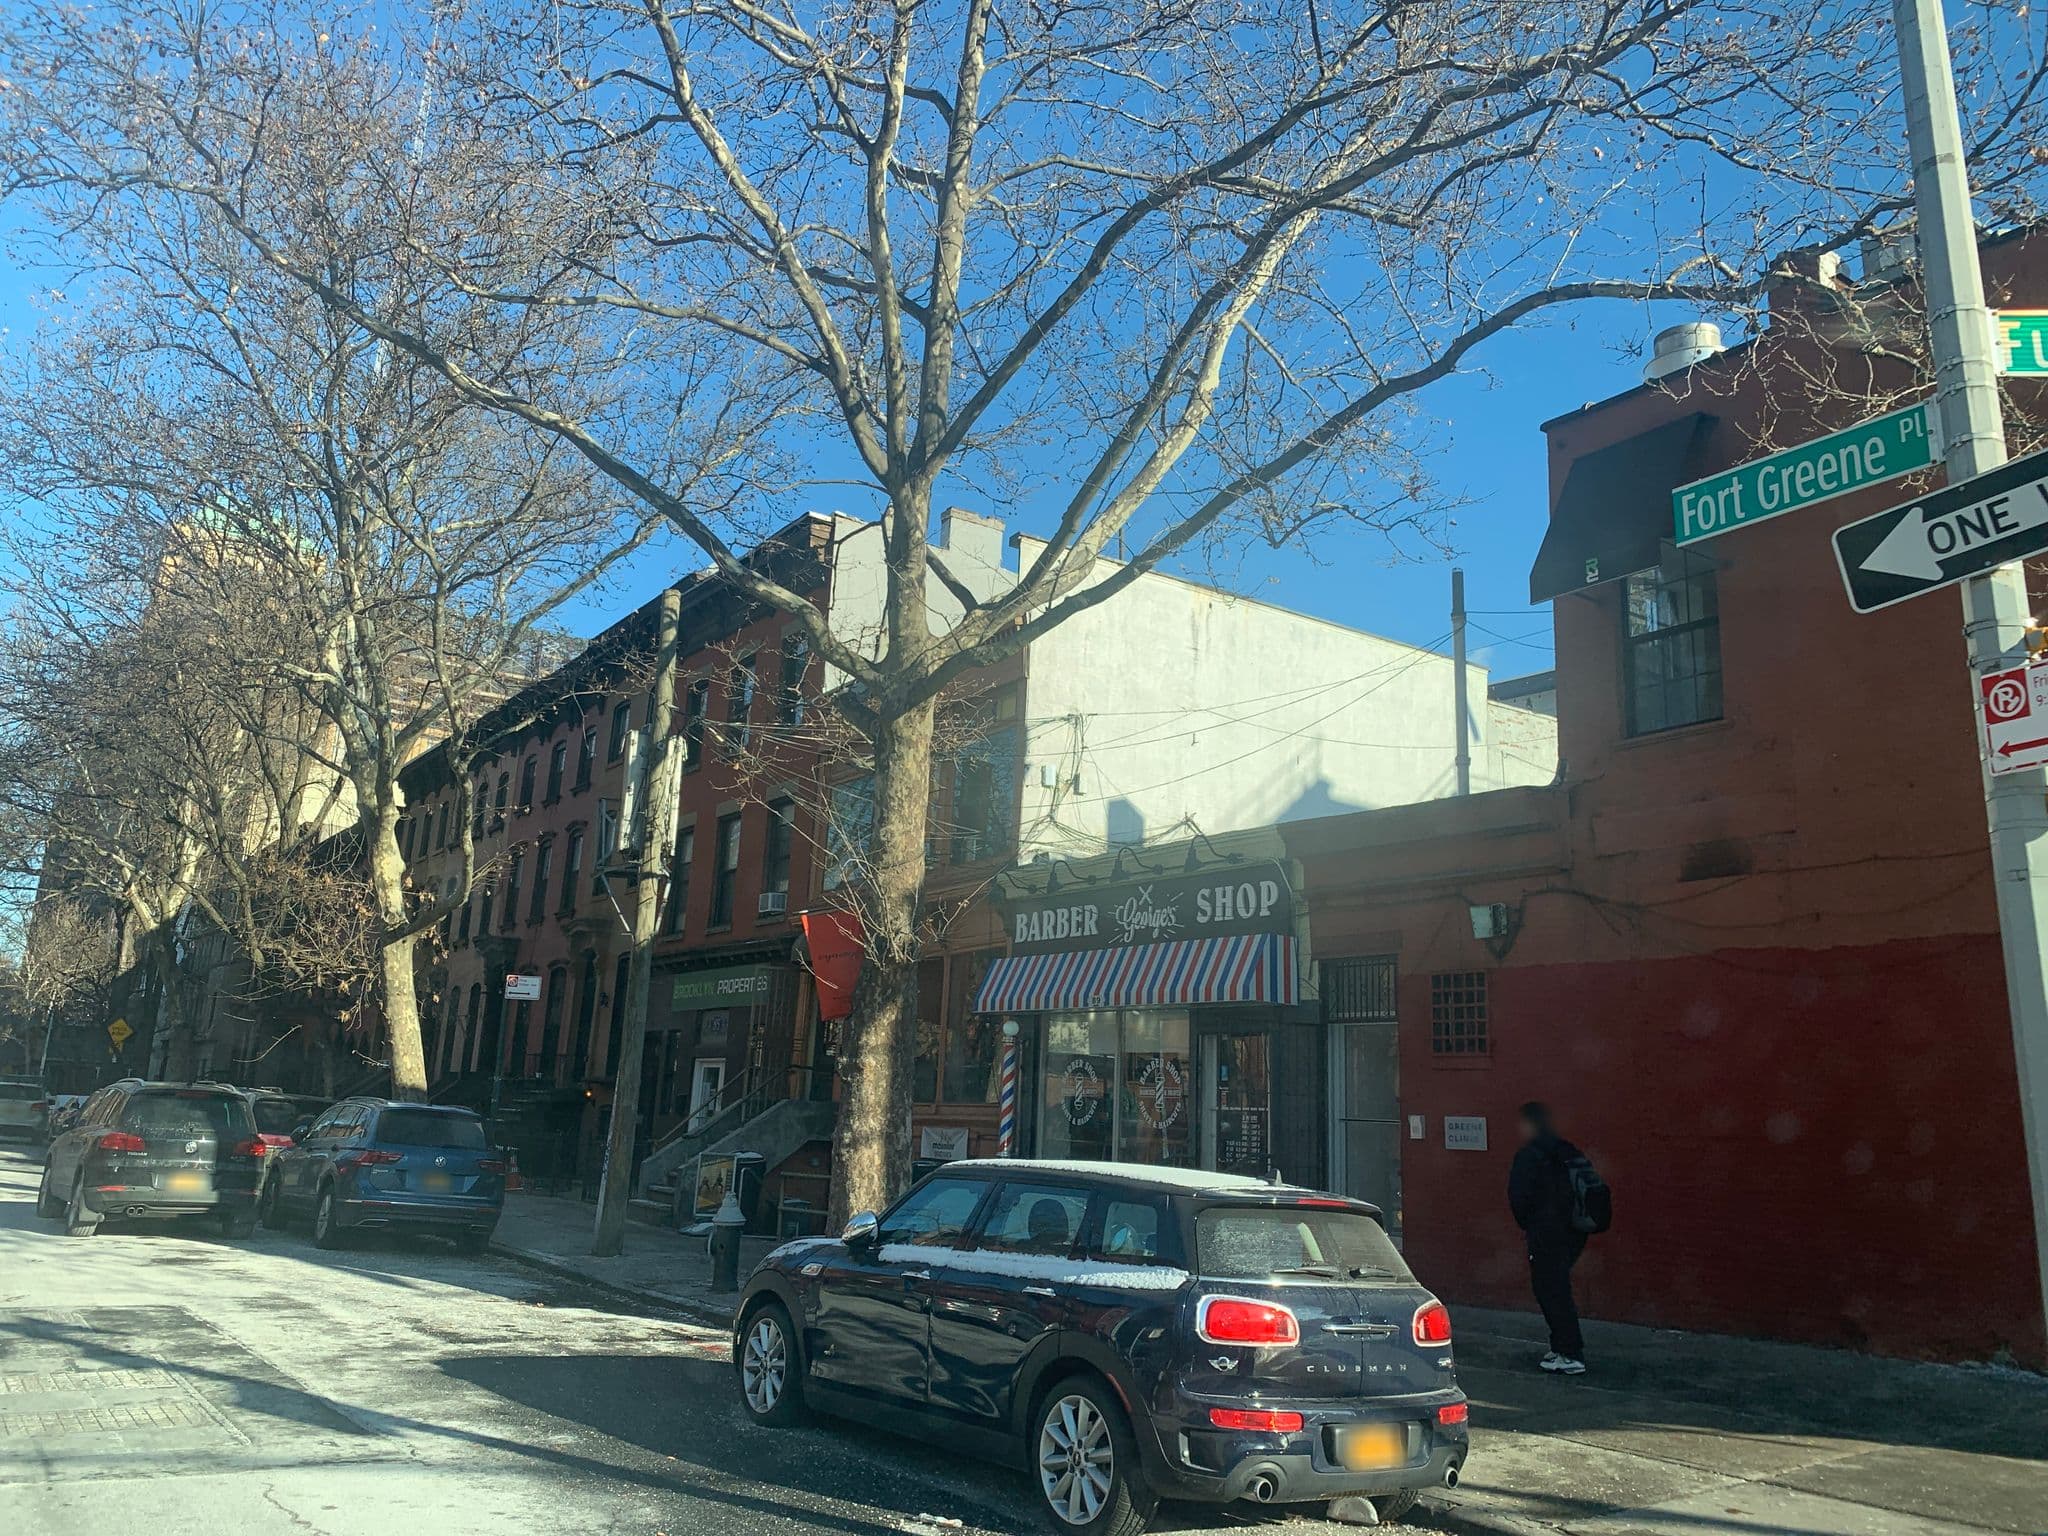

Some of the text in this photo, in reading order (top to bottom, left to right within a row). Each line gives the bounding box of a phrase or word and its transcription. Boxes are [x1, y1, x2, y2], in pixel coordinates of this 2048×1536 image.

[1680, 411, 1924, 537] Fort Greene Pl
[1927, 496, 2020, 555] ONE
[1014, 904, 1098, 944] BARBER
[1115, 896, 1178, 943] George's
[1196, 880, 1279, 924] SHOP
[717, 975, 769, 995] PROPERTES
[1306, 1363, 1407, 1374] CLUBMAN
